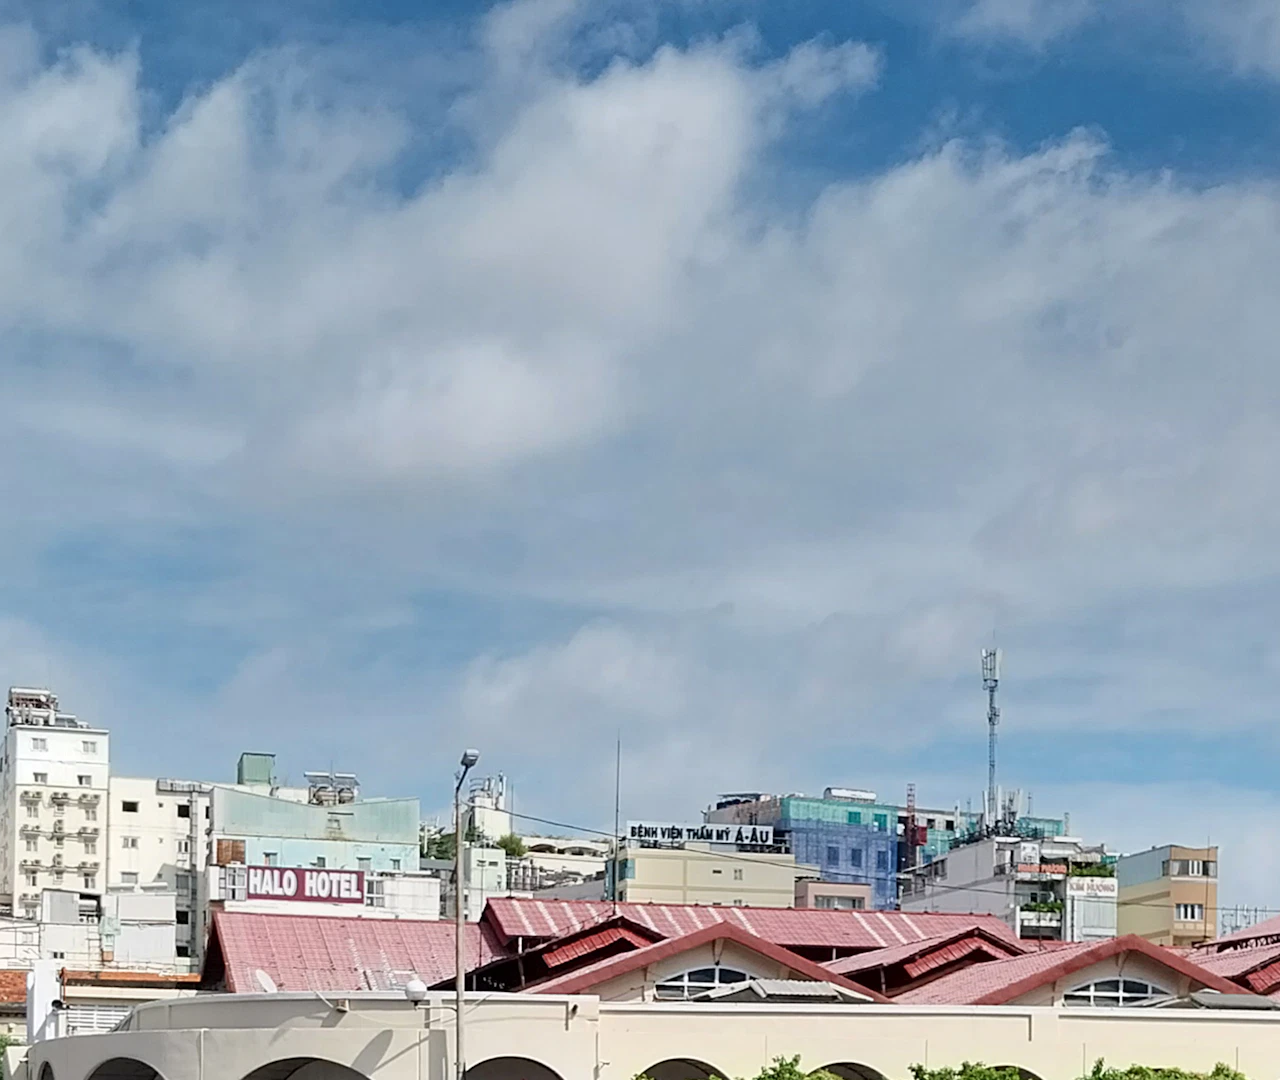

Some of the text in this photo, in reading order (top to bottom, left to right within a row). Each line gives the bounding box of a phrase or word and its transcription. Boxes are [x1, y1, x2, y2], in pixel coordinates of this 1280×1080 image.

[630, 824, 658, 839] BỆNH
[660, 825, 683, 841] VIỆN
[248, 868, 362, 899] HALO HOTEL
